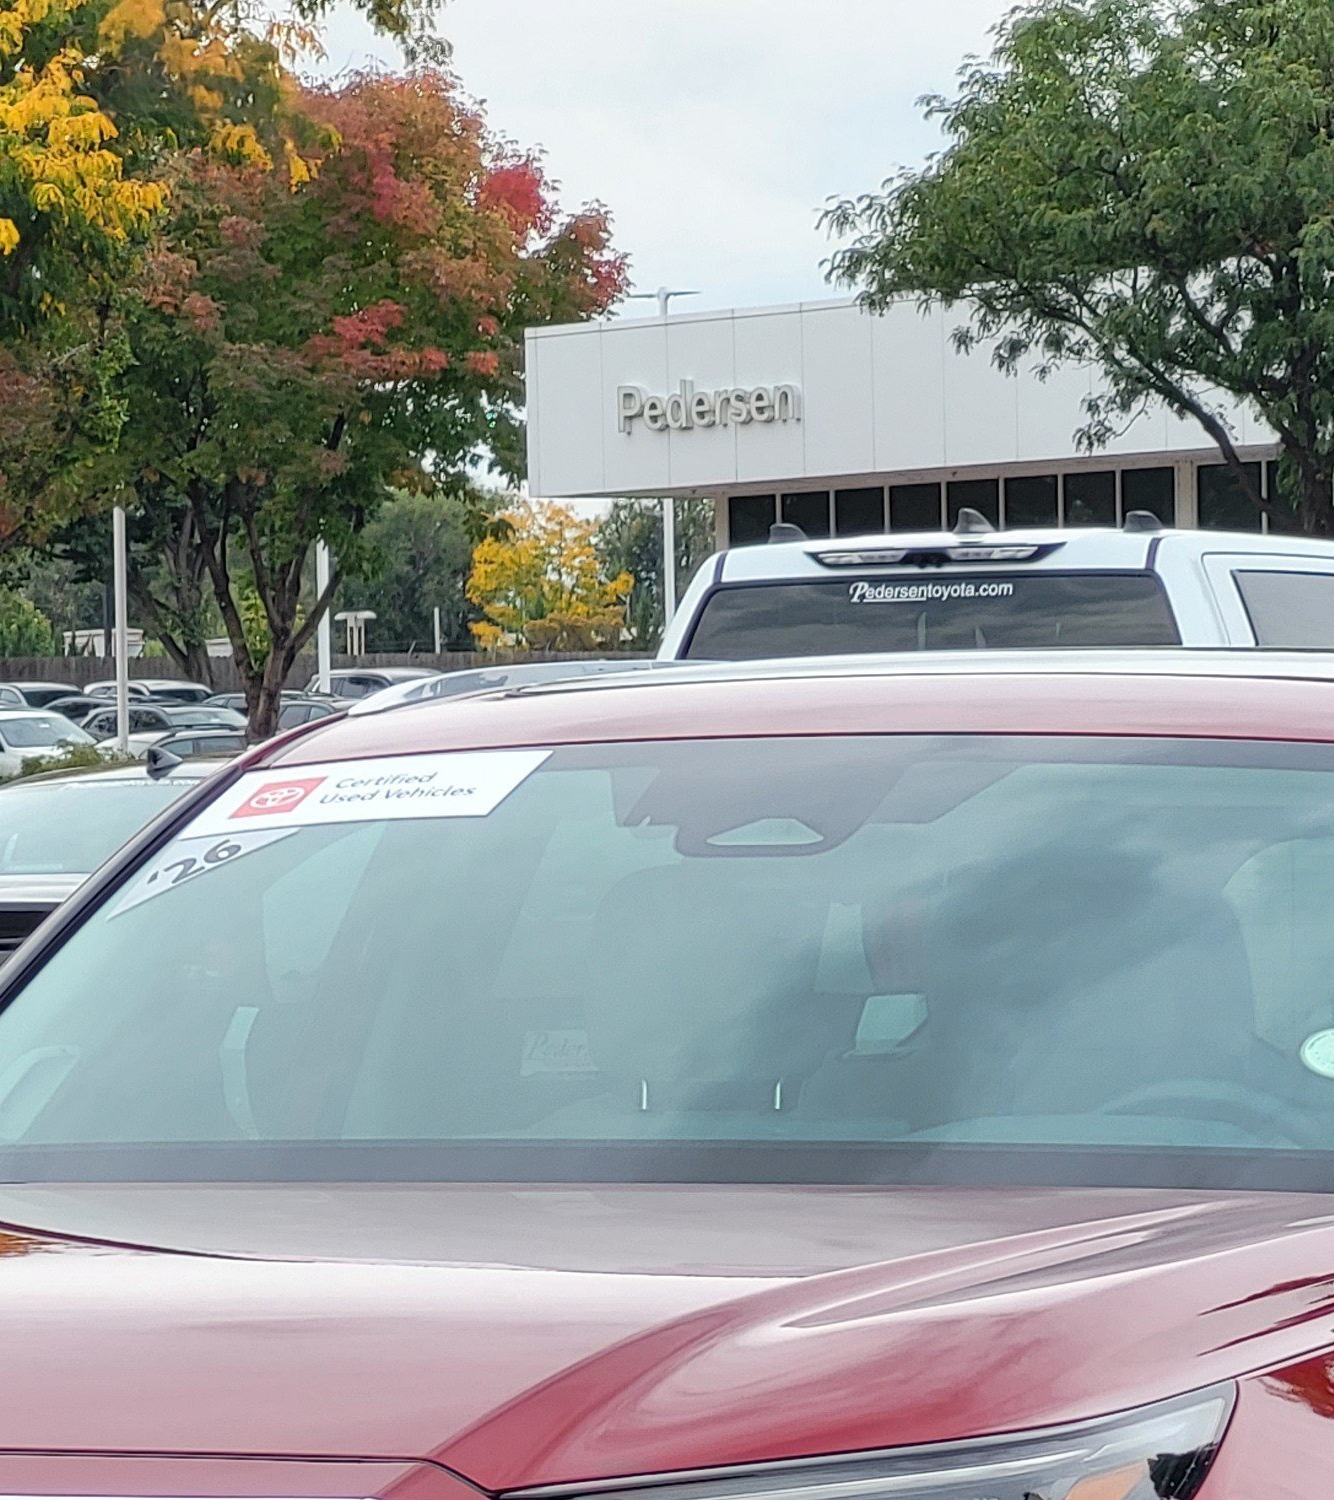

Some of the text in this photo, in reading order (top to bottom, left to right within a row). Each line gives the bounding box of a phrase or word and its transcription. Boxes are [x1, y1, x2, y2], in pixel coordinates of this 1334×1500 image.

[617, 379, 800, 434] Pedersen
[849, 582, 1013, 602] Pedersentoyota.com
[335, 771, 439, 789] Certified
[319, 784, 477, 805] Used Vehicles
